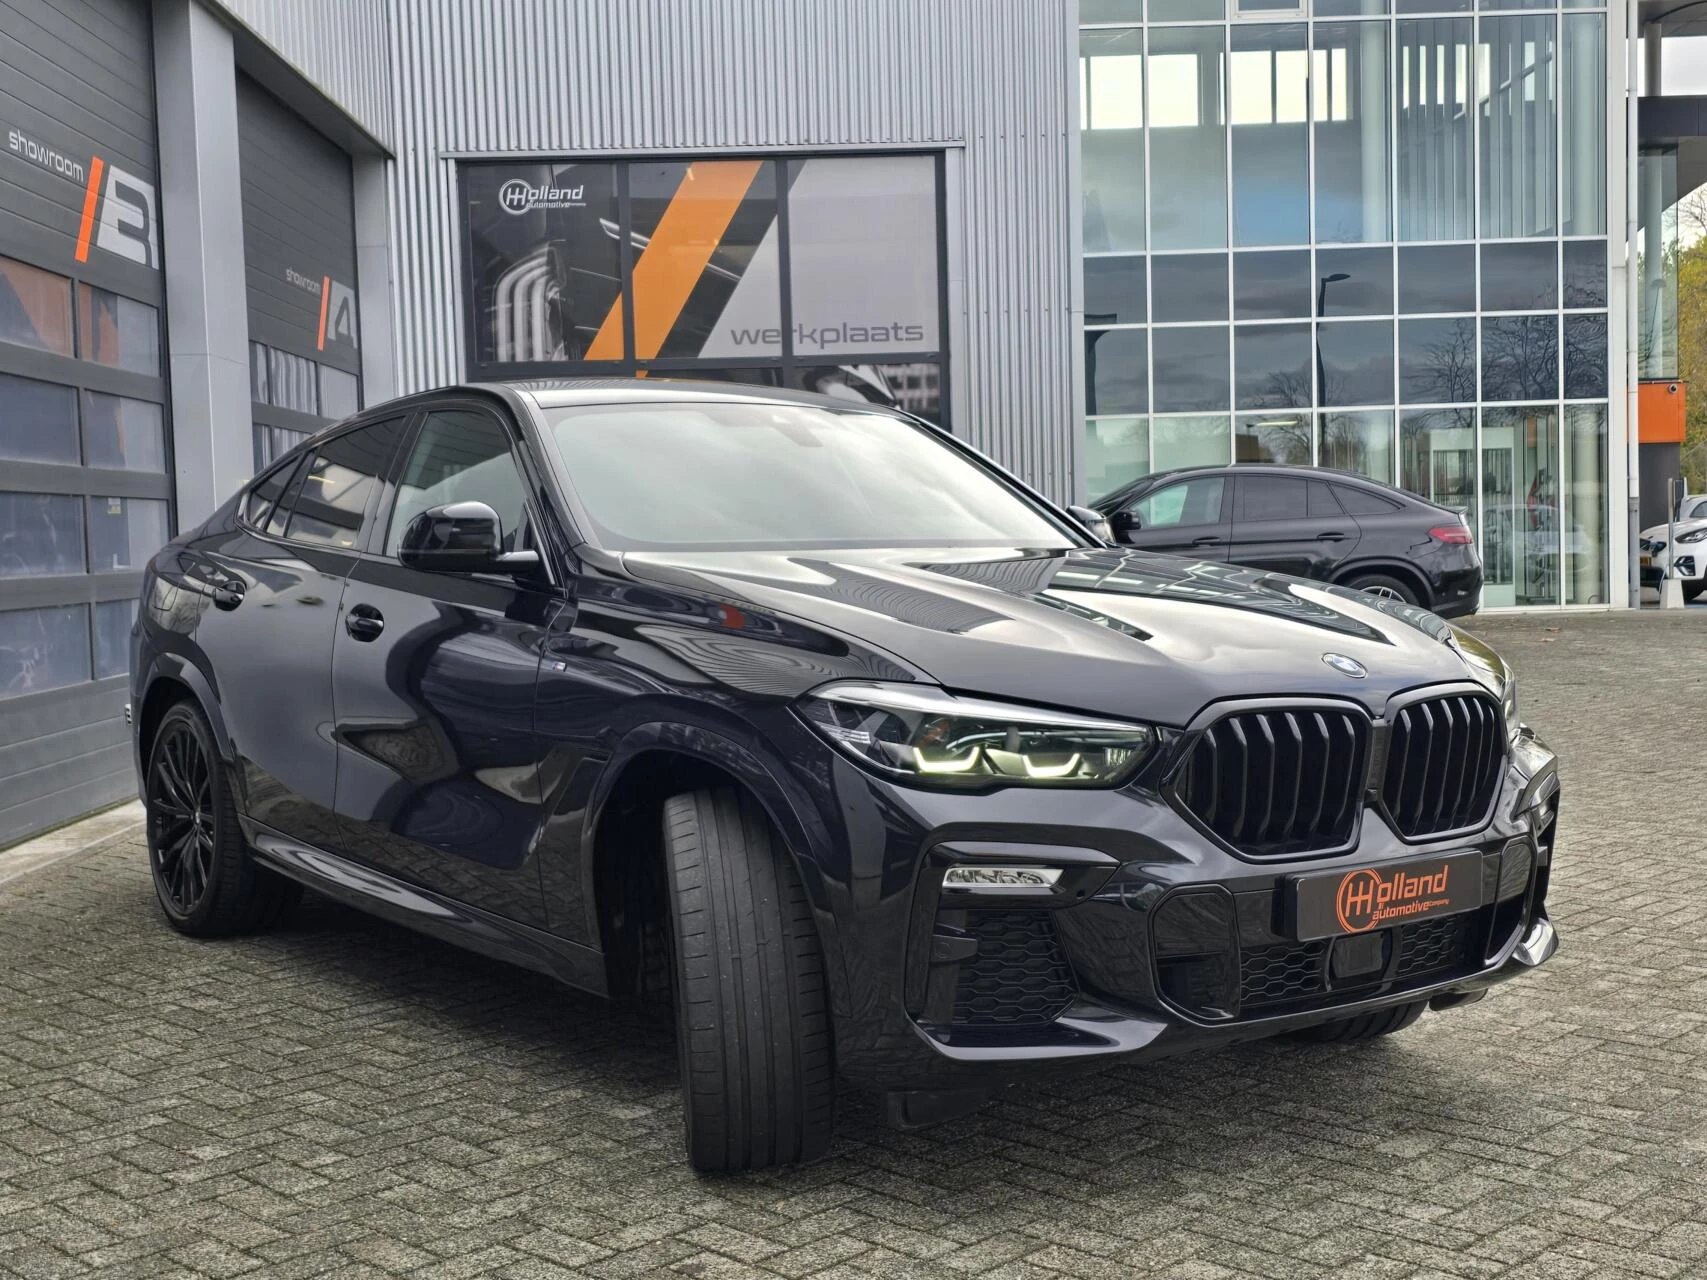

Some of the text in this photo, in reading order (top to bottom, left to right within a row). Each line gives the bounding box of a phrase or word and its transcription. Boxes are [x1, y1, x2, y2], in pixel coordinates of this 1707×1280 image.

[9, 129, 84, 182] showroom
[500, 180, 584, 210] Holland
[527, 200, 569, 208] automotive
[286, 266, 320, 294] showroom
[731, 322, 924, 349] wekplaats
[1339, 865, 1448, 924] Holland
[1372, 901, 1429, 920] automotive
